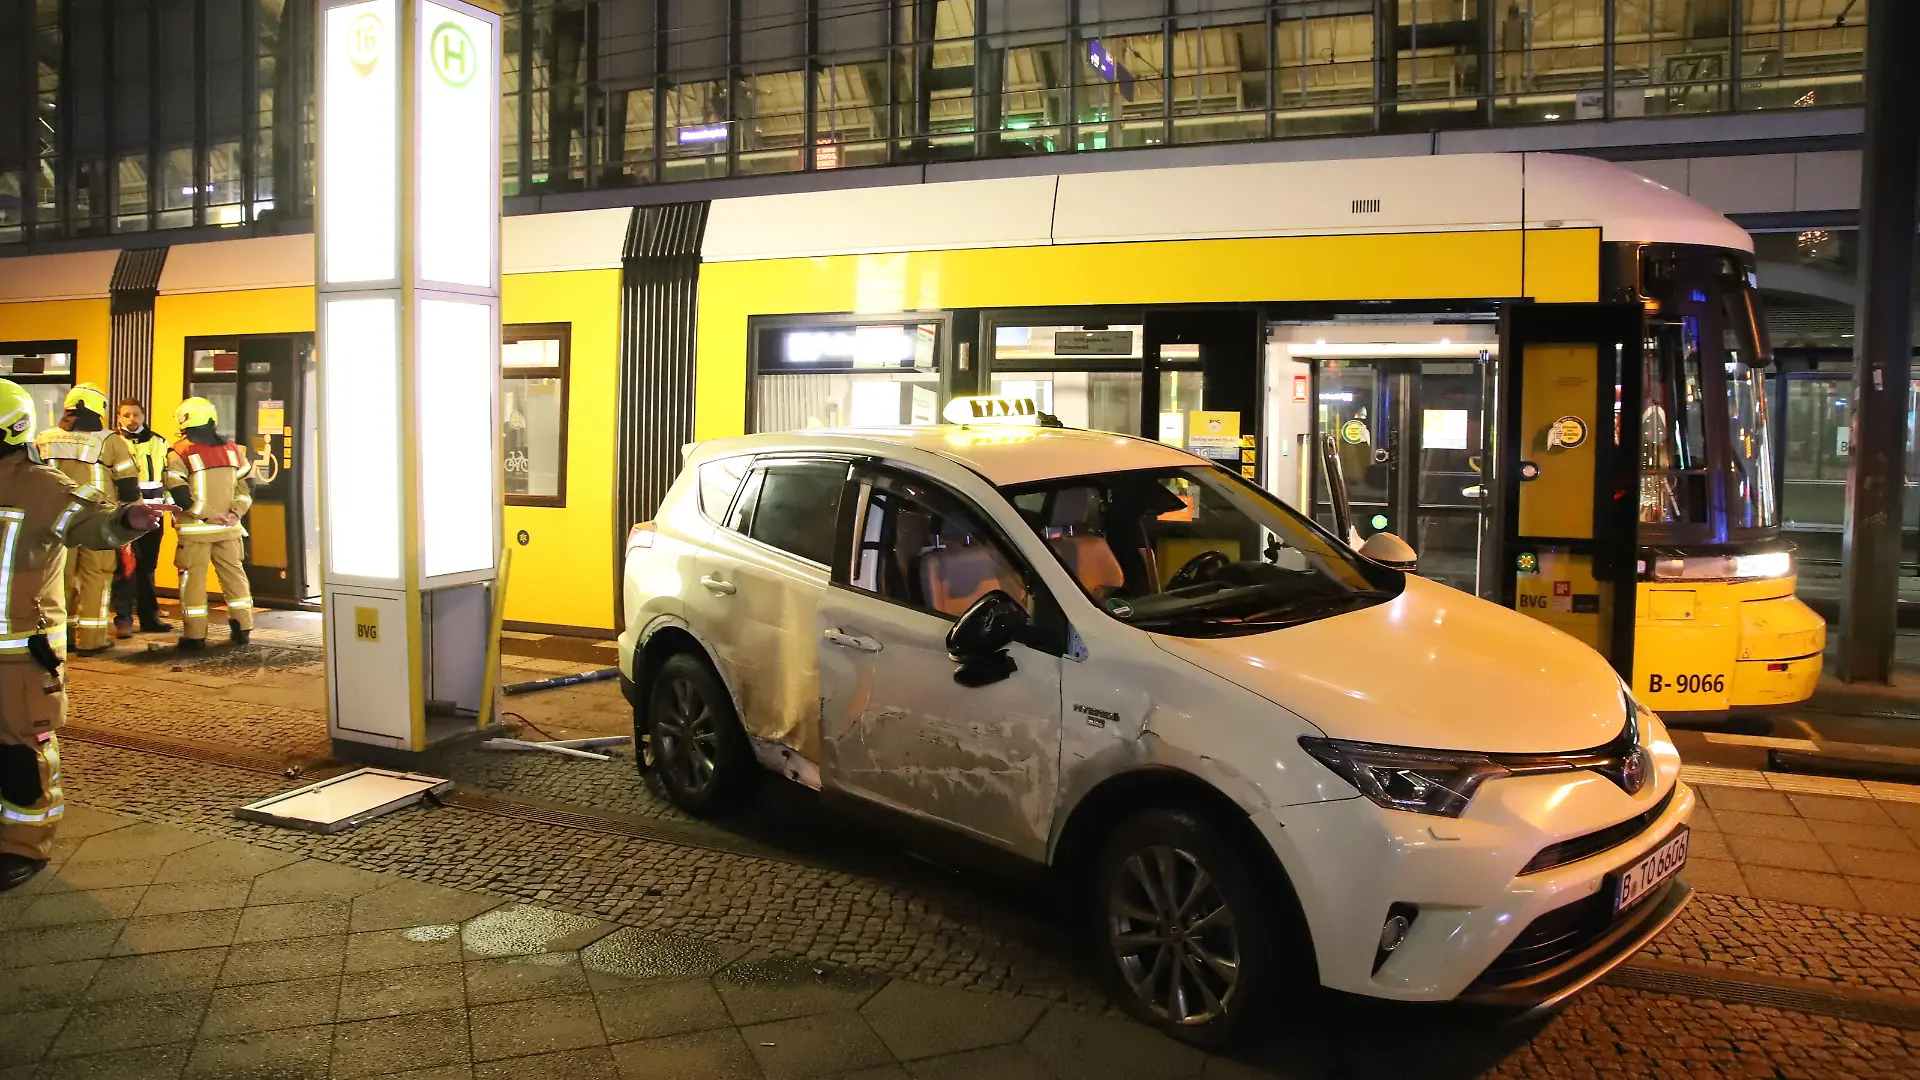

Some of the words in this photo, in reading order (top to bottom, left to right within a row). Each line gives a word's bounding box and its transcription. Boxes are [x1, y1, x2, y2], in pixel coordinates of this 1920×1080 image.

[356, 25, 376, 52] 16
[443, 34, 466, 76] H
[974, 399, 1029, 417] TAXI
[1520, 594, 1548, 609] BVG
[357, 623, 377, 639] BVG
[1621, 873, 1632, 903] B
